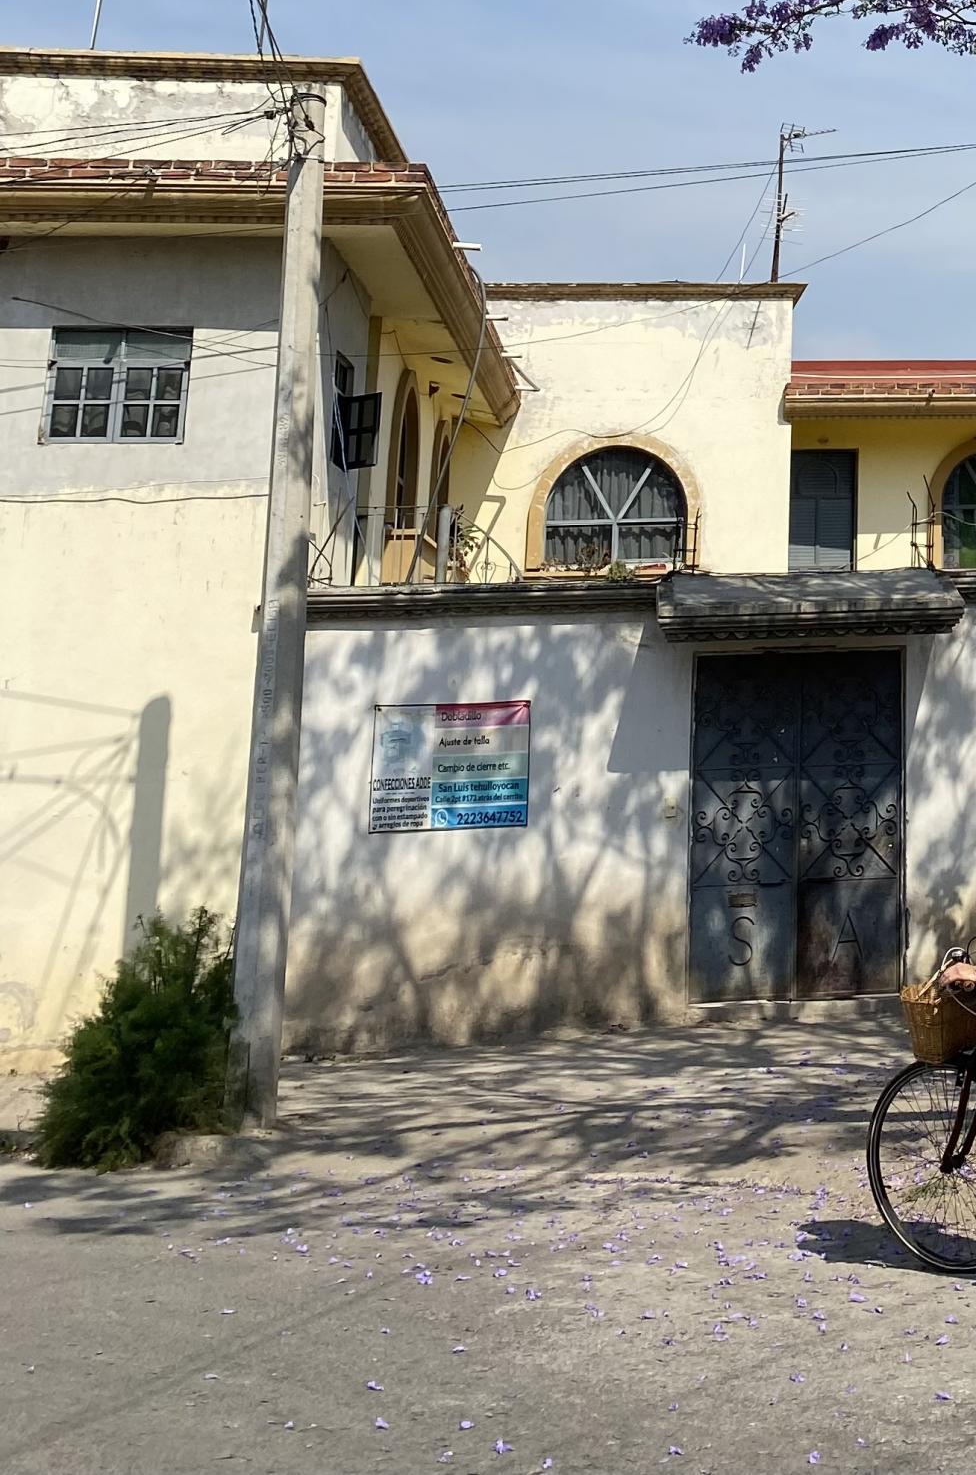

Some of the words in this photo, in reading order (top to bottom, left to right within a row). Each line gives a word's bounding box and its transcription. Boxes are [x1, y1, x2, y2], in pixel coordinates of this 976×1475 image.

[441, 711, 482, 722] Dobladillo
[438, 736, 461, 748] Ajuste
[462, 735, 472, 745] de
[474, 735, 490, 745] talla
[437, 763, 465, 773] Cambio
[466, 763, 476, 772] de
[476, 762, 497, 771] cierre
[373, 777, 415, 791] CONFECCIONES
[438, 783, 453, 793] San
[454, 782, 469, 792] Luis
[435, 795, 450, 803] Calle
[492, 793, 502, 801] del
[386, 804, 427, 812] peregrinación
[397, 812, 428, 820] estampado
[379, 821, 401, 829] arreglos
